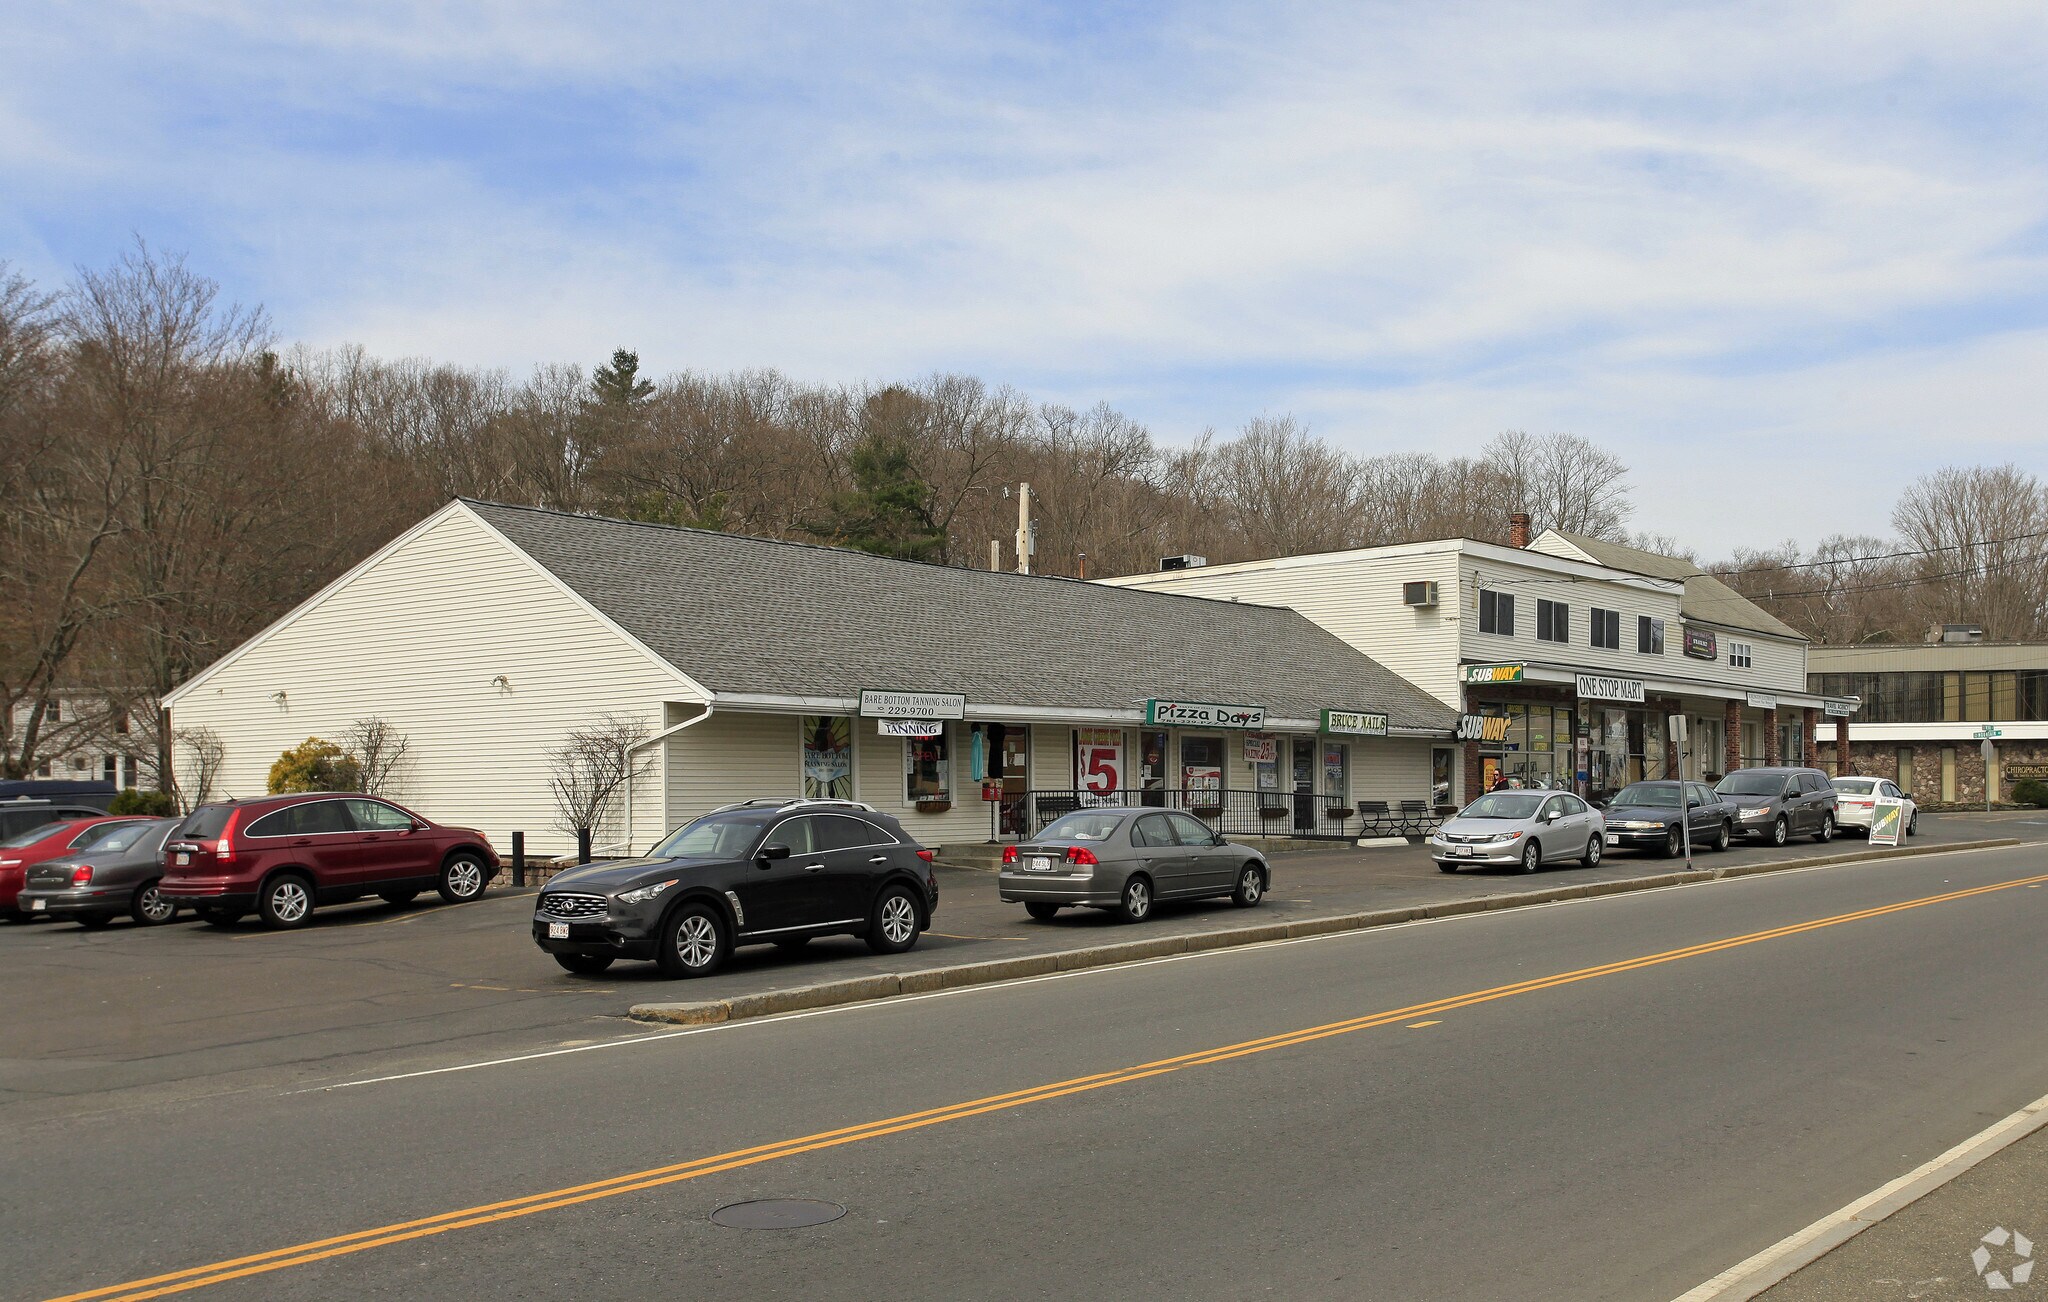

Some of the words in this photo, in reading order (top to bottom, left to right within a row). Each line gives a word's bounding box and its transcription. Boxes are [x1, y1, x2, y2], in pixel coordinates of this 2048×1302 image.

[1469, 666, 1520, 682] SUBWAY
[1580, 677, 1597, 695] ONE
[1599, 678, 1618, 697] STOP
[1620, 680, 1641, 699] MART
[865, 695, 882, 703] BARE
[884, 695, 910, 705] BOTTOM
[912, 696, 940, 706] TANNING
[941, 698, 961, 707] SALON
[888, 706, 934, 716] 229-9700
[1158, 704, 1209, 720] Pizza
[1217, 709, 1261, 727] Days
[885, 723, 937, 735] TANNING
[1331, 713, 1358, 728] BRUCE
[1361, 715, 1386, 730] NAILS
[1457, 714, 1512, 741] SUBWAY
[1872, 806, 1900, 835] SUBWAY
